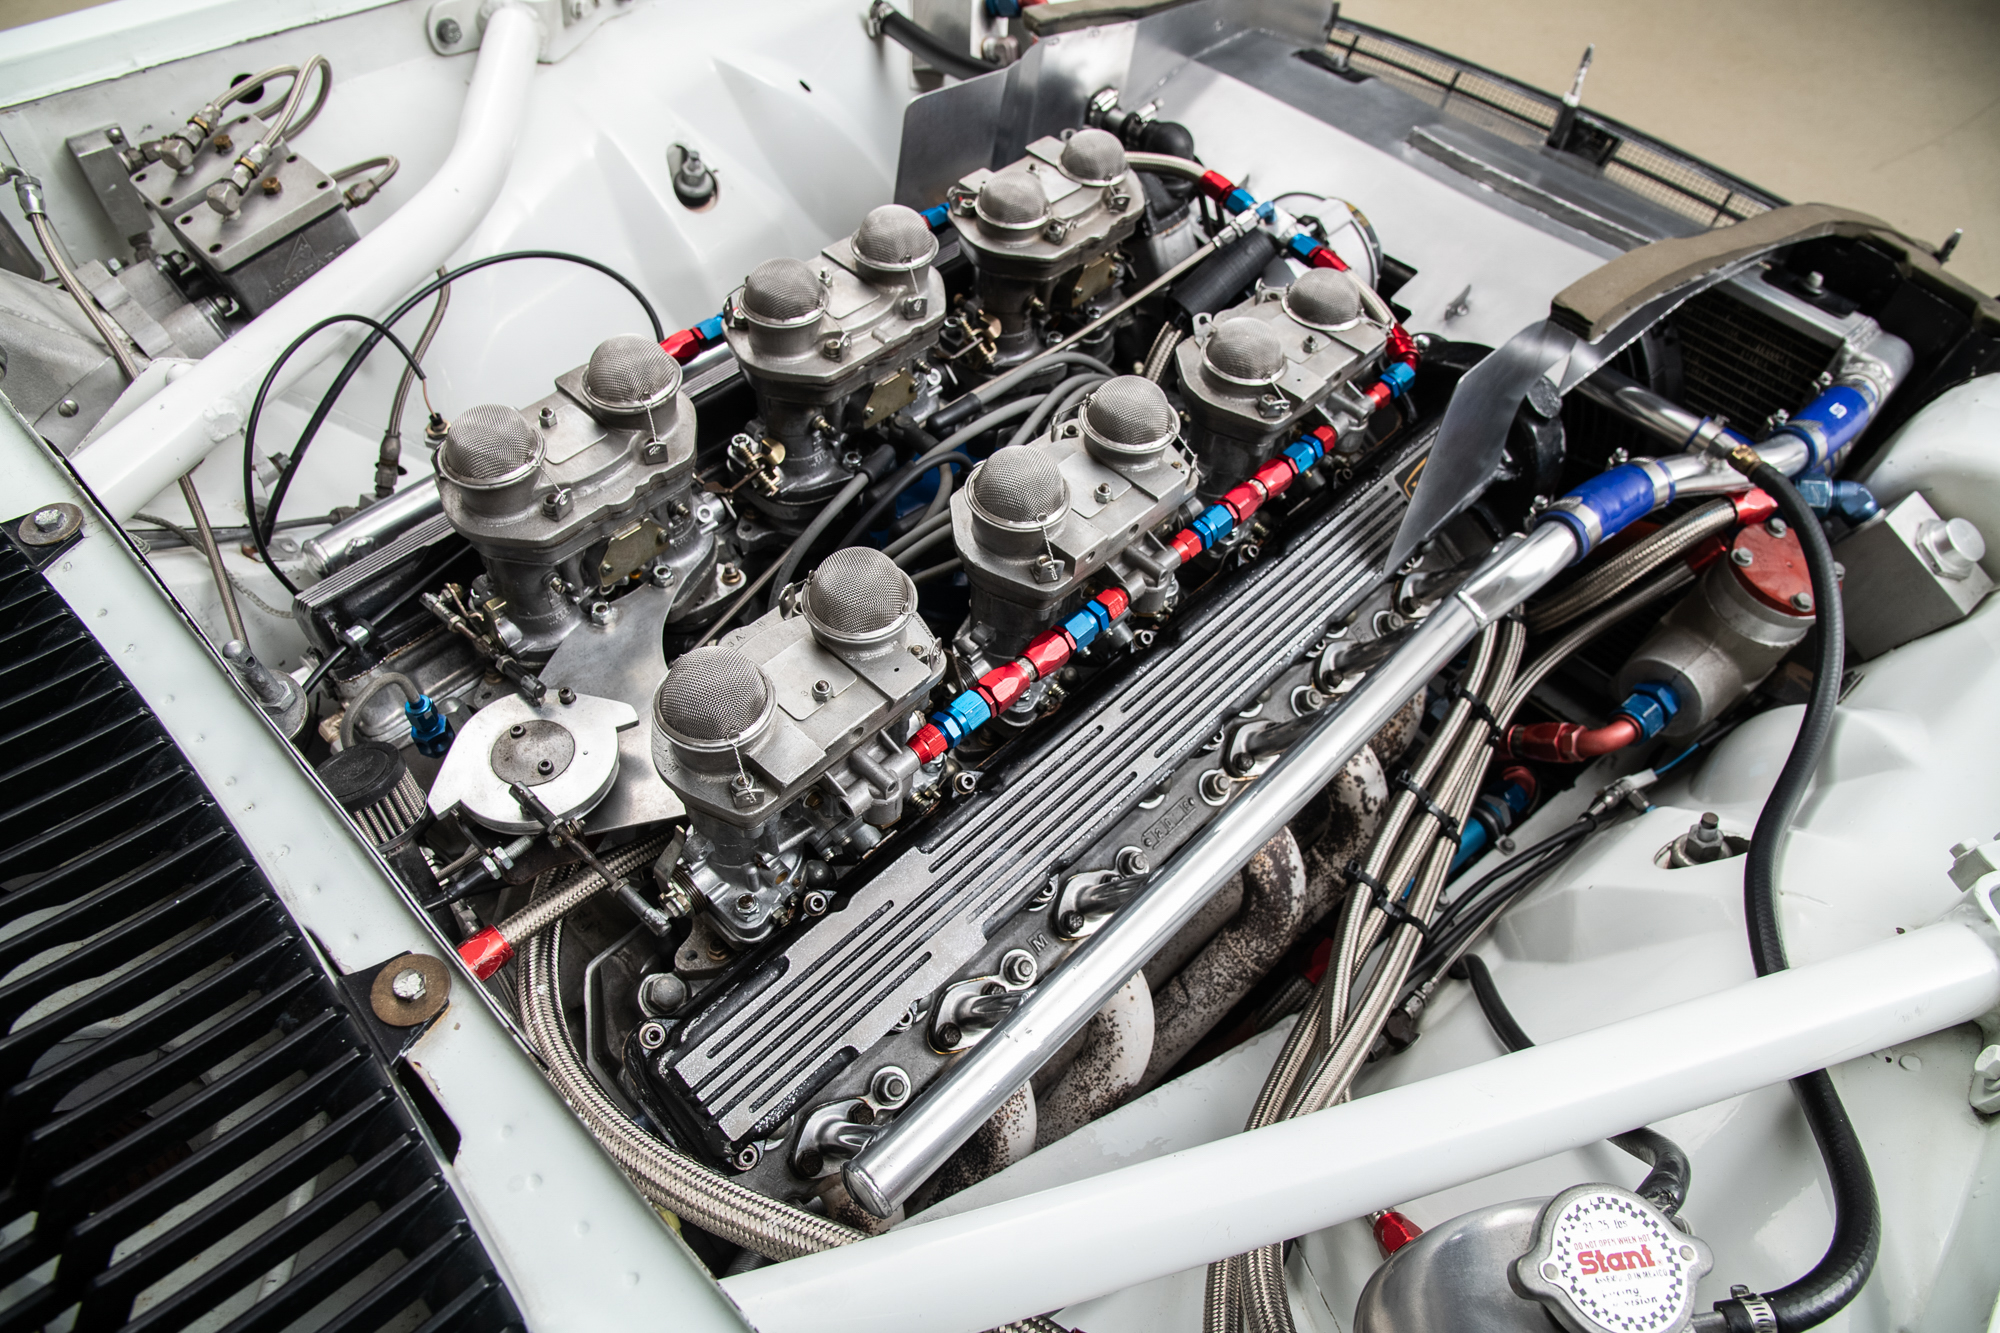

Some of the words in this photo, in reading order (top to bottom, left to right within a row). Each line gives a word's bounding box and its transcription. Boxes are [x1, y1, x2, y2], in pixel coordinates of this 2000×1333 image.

[267, 243, 346, 300] AIRHEART
[1573, 1242, 1584, 1251] DO
[1584, 1240, 1597, 1250] NOT
[1599, 1237, 1617, 1248] OPEN
[1617, 1235, 1637, 1246] WHEN
[1638, 1233, 1651, 1243] HOT
[1577, 1243, 1656, 1276] Stant
